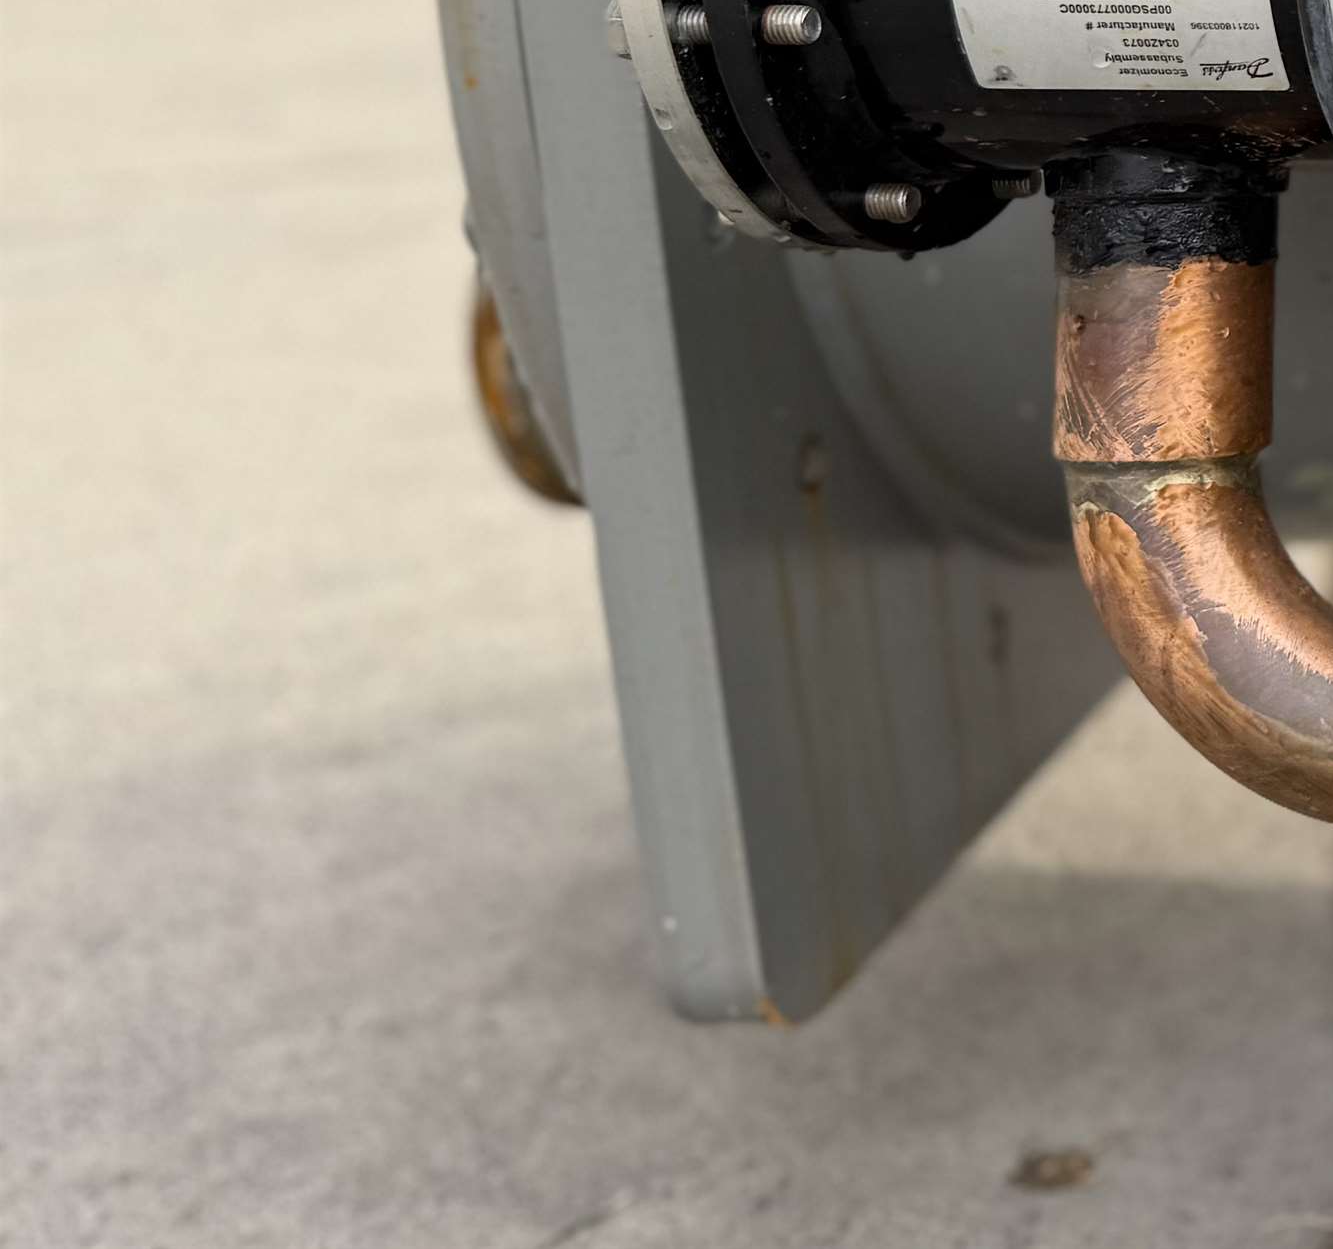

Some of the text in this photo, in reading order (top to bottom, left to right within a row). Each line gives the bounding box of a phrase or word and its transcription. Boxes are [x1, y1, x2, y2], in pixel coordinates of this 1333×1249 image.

[1084, 21, 1176, 32] Manufacturer #
[1122, 38, 1180, 48] 034Z0073
[1104, 52, 1184, 64] Subassembly
[1118, 68, 1189, 78] Economizer
[1199, 57, 1274, 81] Danfoss
